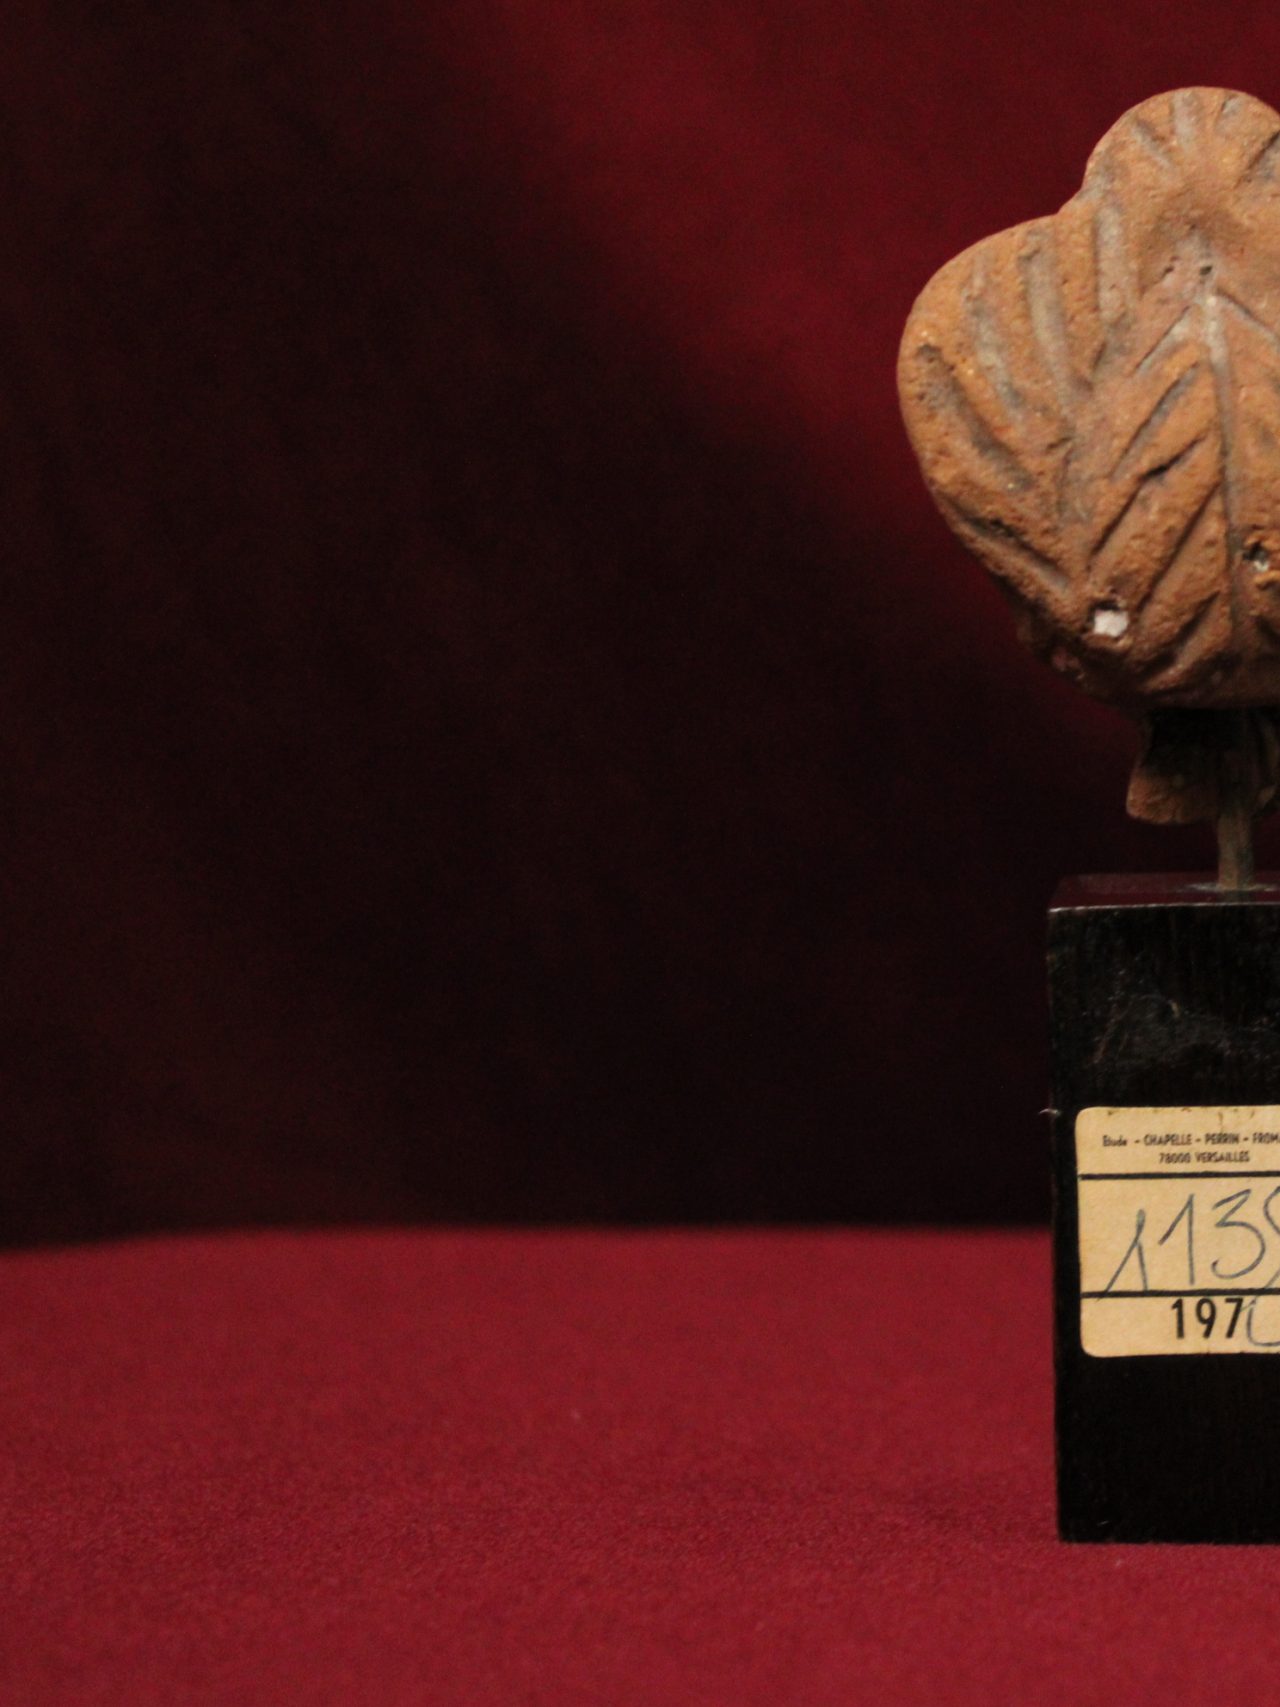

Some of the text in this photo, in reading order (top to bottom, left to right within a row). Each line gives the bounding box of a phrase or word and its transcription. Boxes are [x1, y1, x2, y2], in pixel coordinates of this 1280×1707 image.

[1143, 1133, 1192, 1146] CHAPELLE
[1204, 1131, 1240, 1145] PERRIN
[1158, 1150, 1251, 1164] 78000 VERSAILLES
